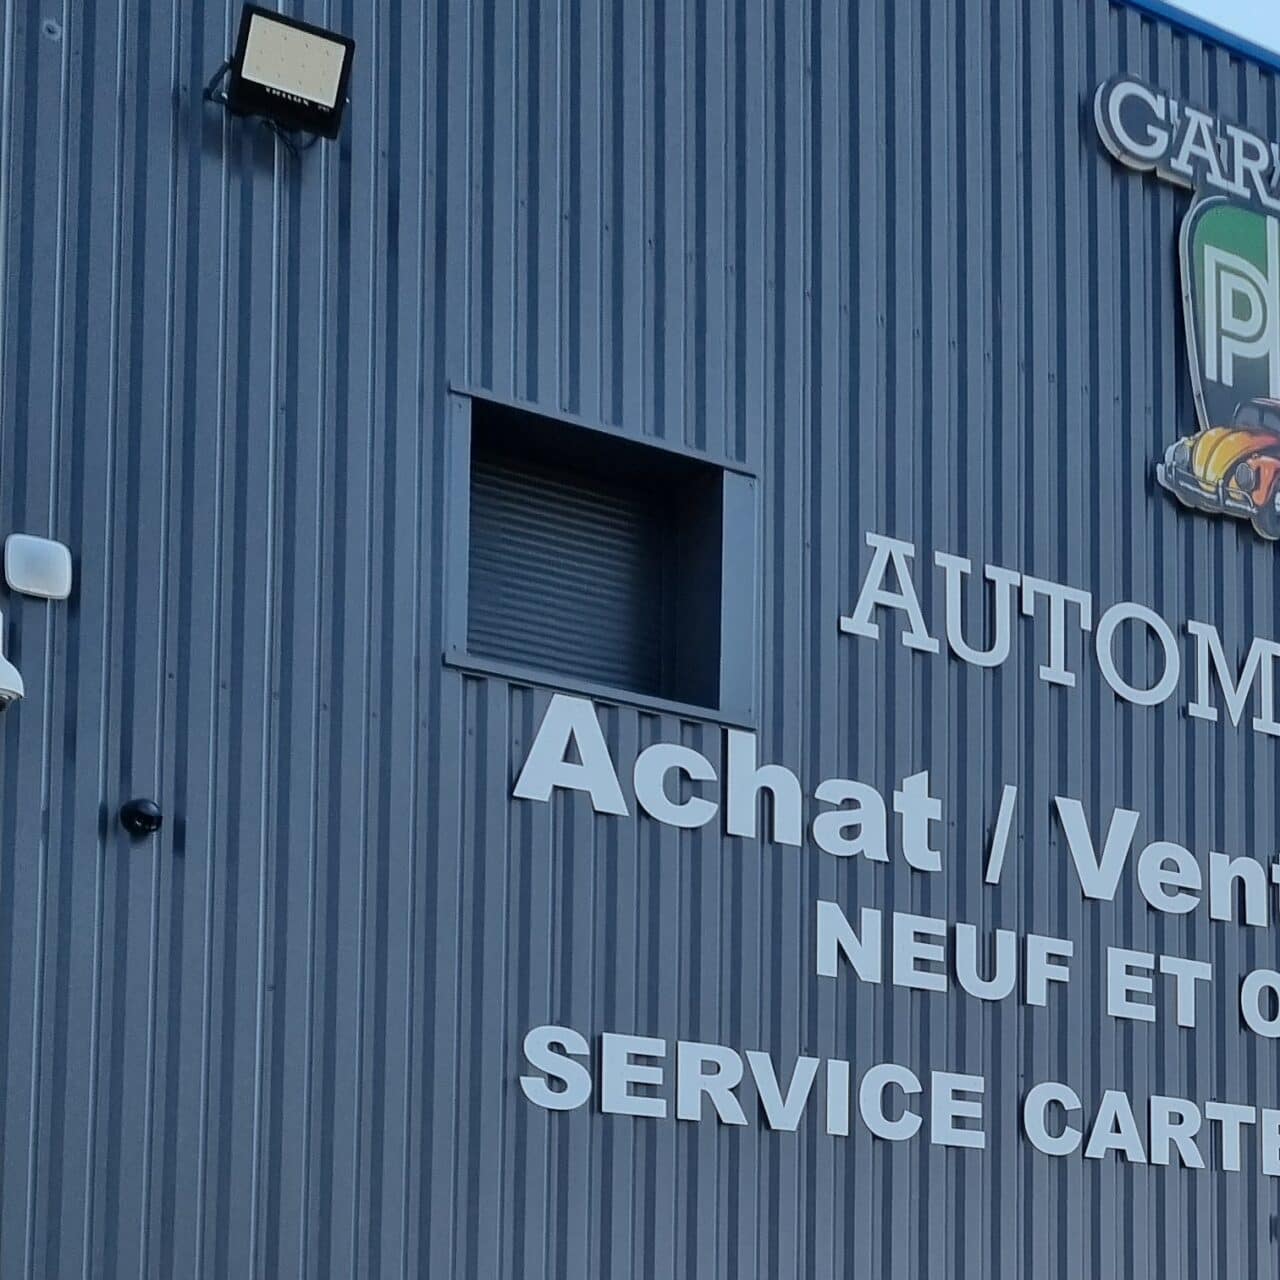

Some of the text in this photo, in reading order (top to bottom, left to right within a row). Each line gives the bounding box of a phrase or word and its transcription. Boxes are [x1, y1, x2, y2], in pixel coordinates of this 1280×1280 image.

[513, 692, 942, 872] Achat
[985, 784, 1018, 885] /
[816, 899, 1074, 1007] NEUF
[1107, 945, 1212, 1028] ET
[519, 1025, 986, 1150] SERVICE
